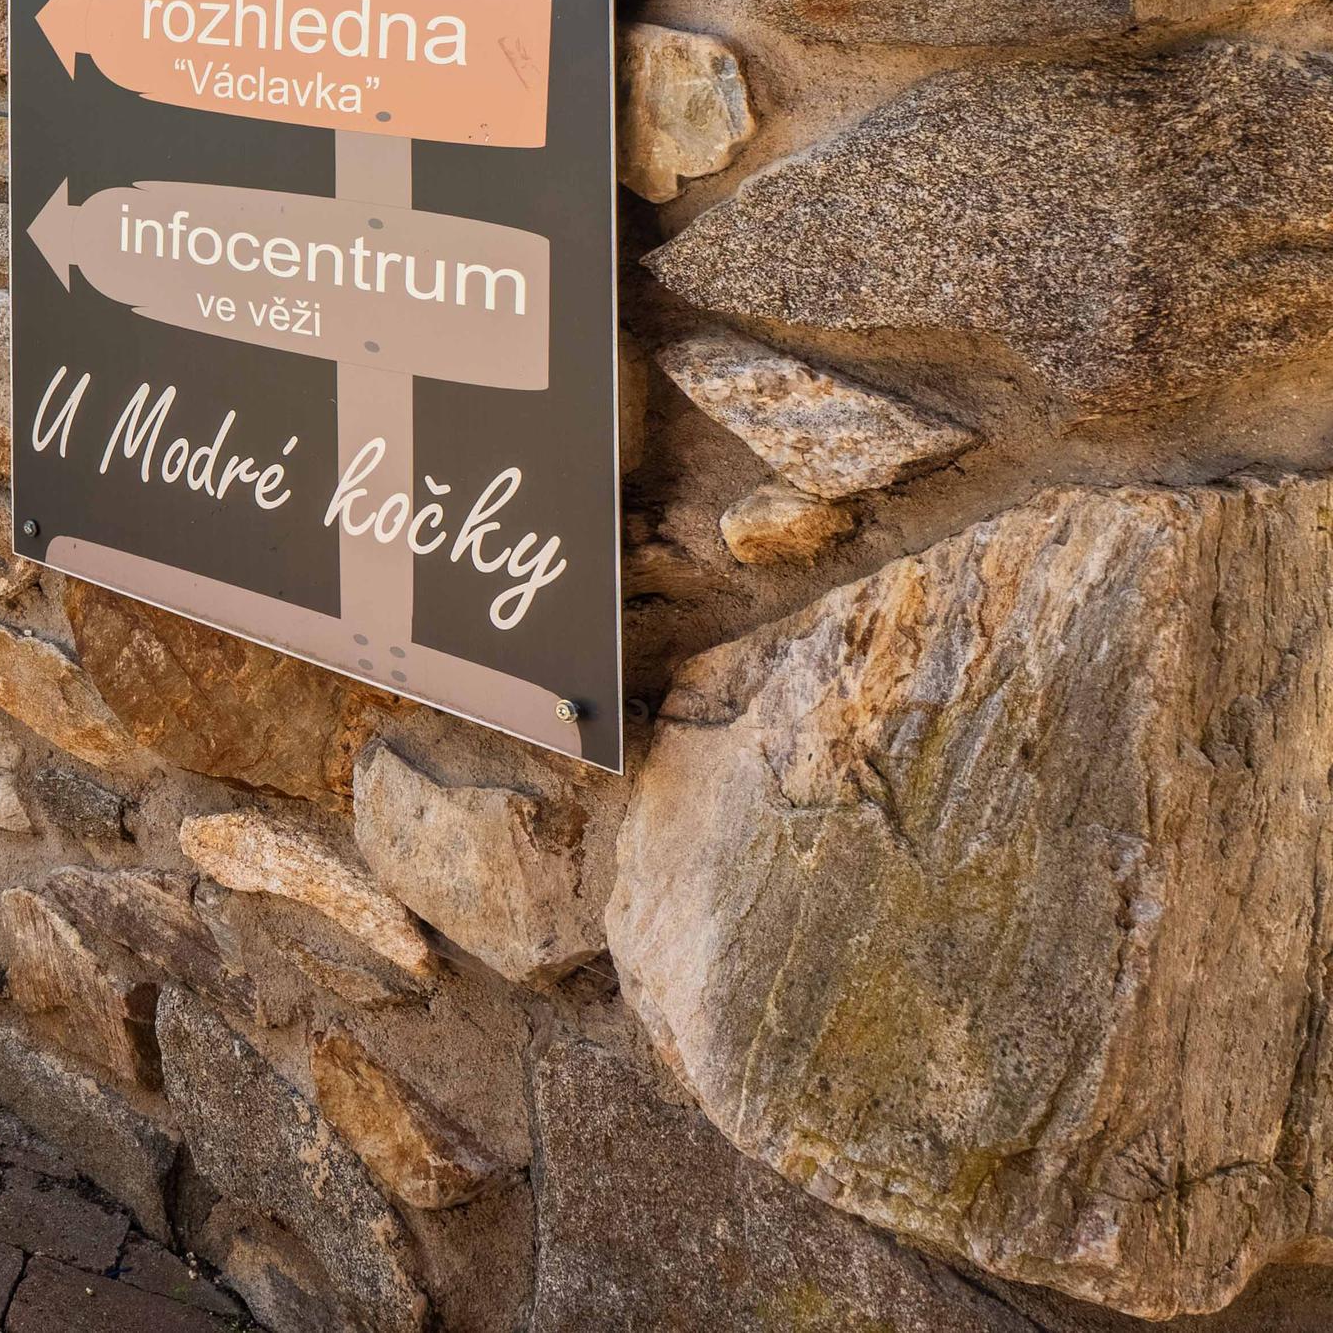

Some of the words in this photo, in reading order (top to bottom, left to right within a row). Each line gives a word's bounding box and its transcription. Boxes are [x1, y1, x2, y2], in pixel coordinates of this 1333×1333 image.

[119, 204, 527, 315] infocentrum
[196, 292, 236, 322] ve
[248, 295, 323, 339] věži
[32, 365, 91, 458] U
[100, 382, 298, 510] Modré
[323, 437, 568, 630] kočky
